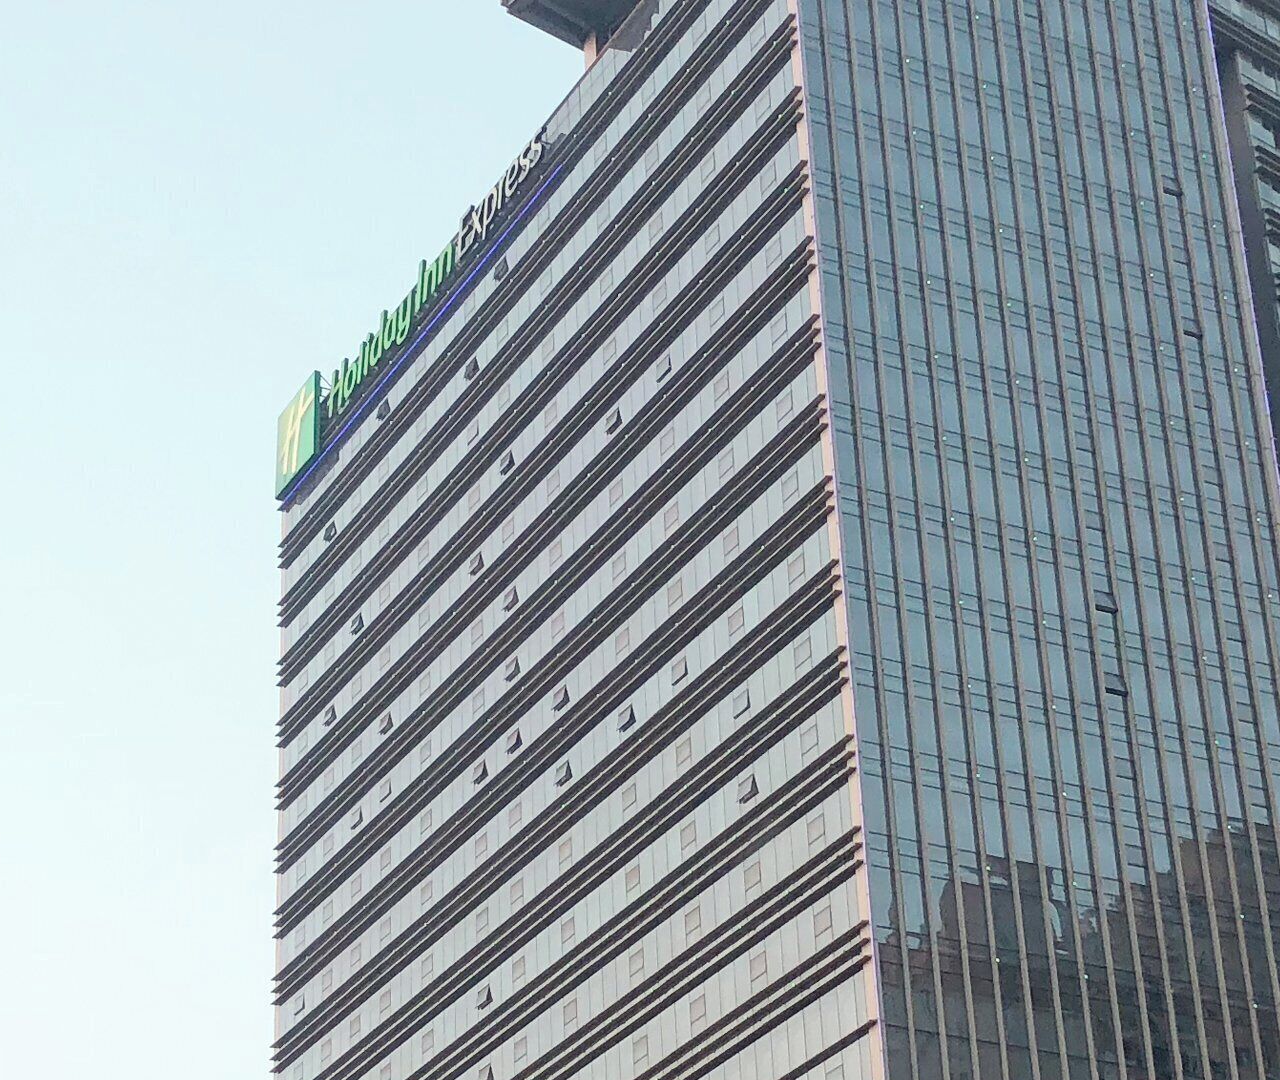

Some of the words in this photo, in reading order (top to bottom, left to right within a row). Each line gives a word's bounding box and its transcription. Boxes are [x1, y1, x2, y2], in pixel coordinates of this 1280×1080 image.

[326, 292, 413, 419] Holiday
[416, 242, 454, 314] Inn
[455, 135, 544, 257] Express
